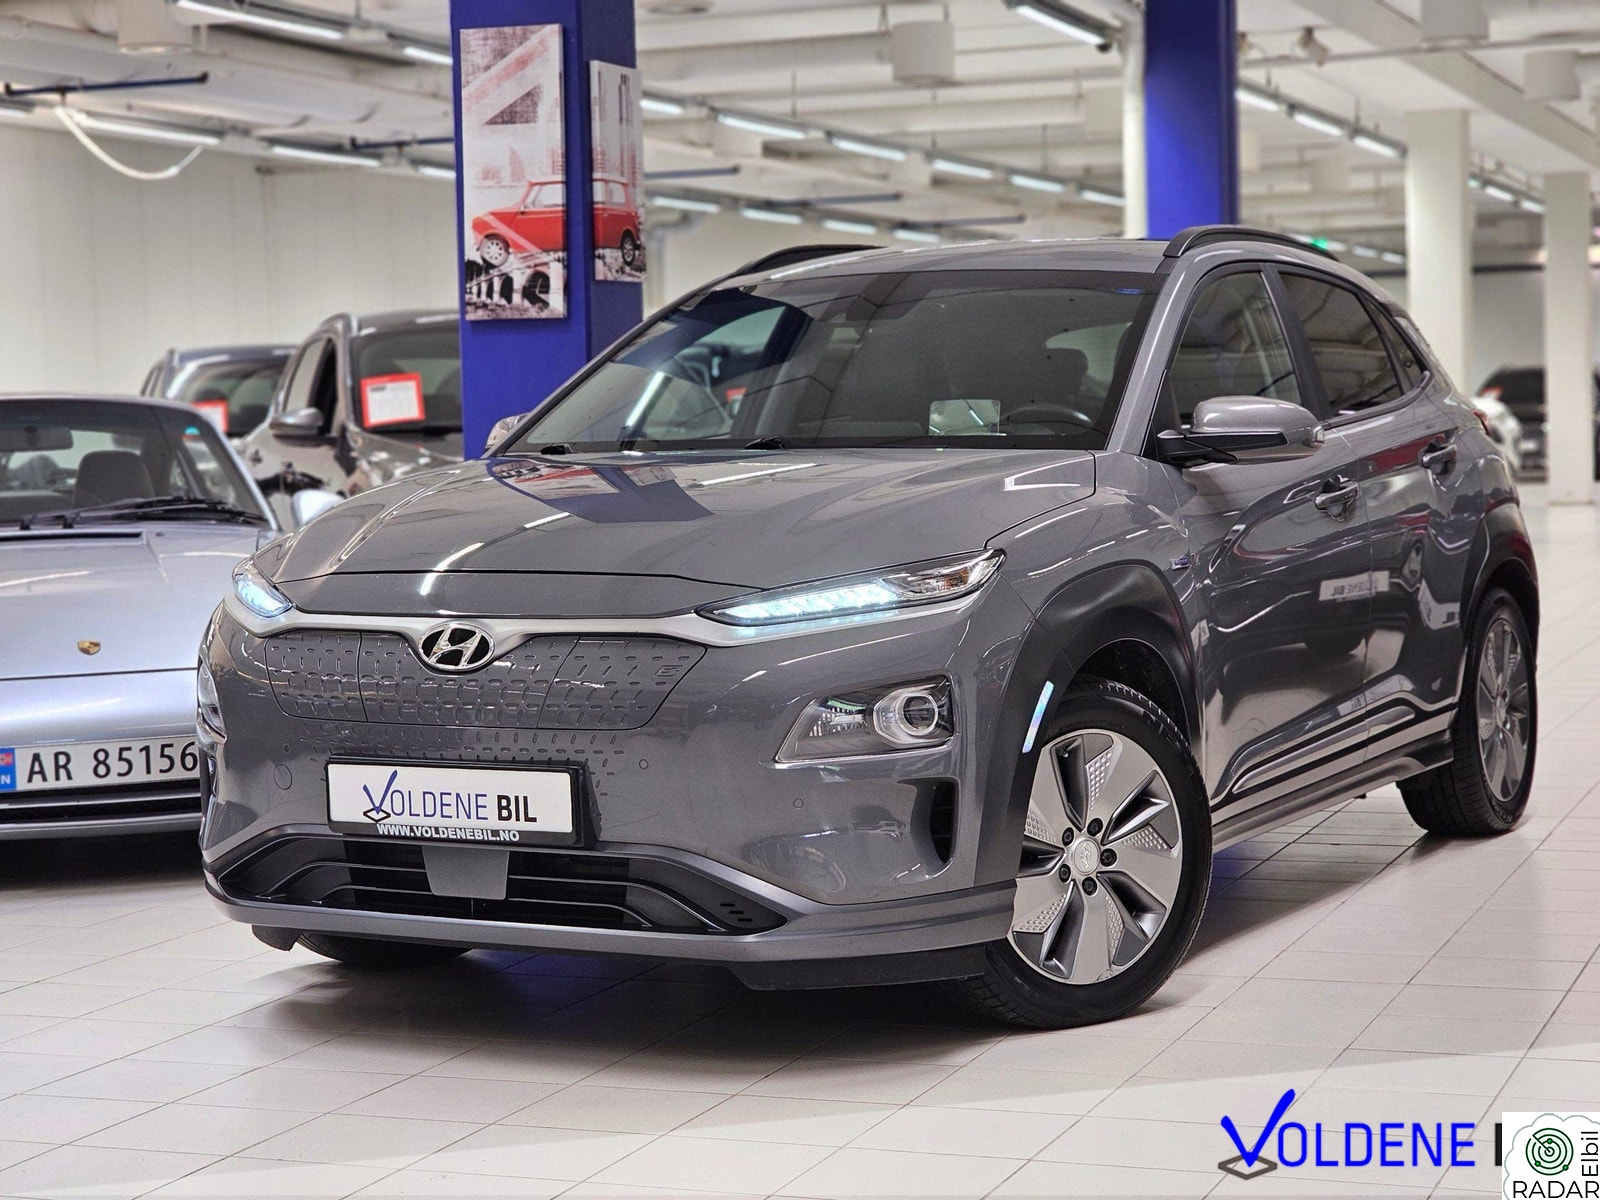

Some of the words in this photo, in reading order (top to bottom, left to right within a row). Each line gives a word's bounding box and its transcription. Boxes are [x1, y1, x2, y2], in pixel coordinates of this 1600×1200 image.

[27, 752, 73, 784] AR
[92, 741, 198, 779] 85156
[363, 769, 489, 821] VOLDENE
[496, 794, 537, 823] BIL
[376, 823, 520, 842] WWW.VOLDENEBIL.NO
